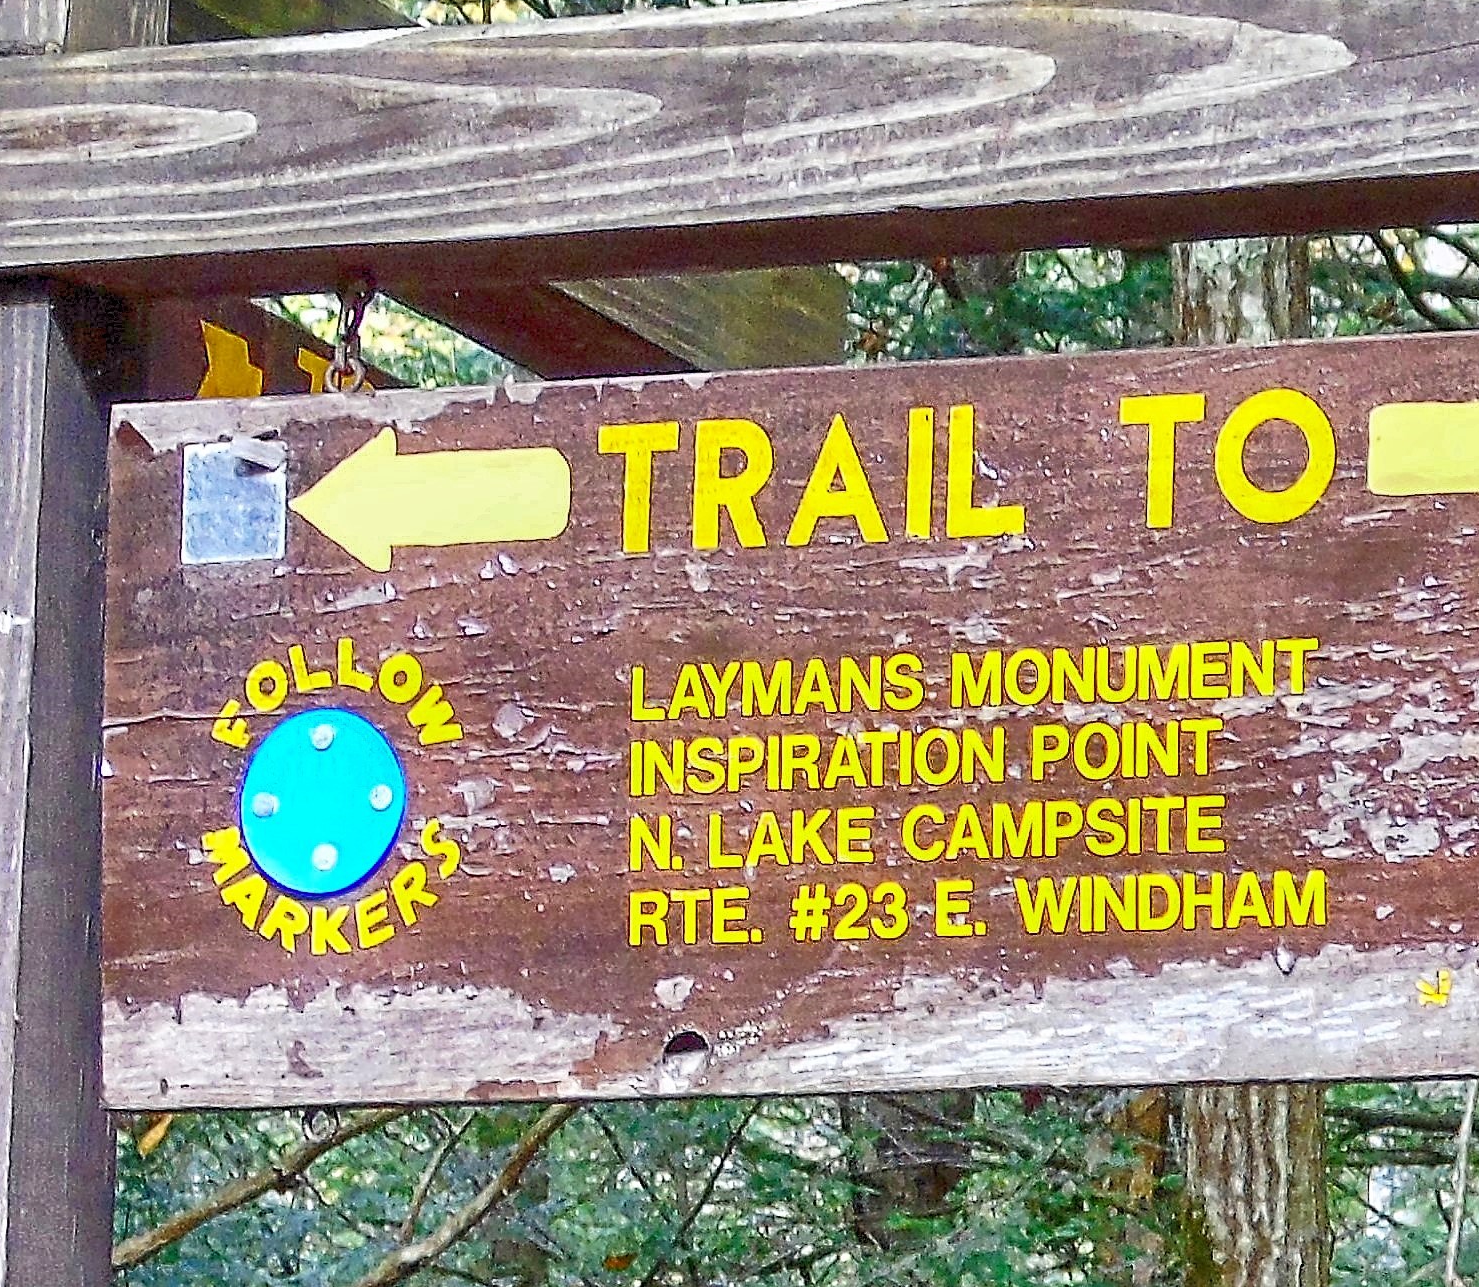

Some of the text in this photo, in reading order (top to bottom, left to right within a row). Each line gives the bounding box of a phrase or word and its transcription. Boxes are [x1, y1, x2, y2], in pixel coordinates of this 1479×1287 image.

[597, 386, 1337, 556] TRAIL TO
[210, 636, 465, 750] FOLLOW
[629, 652, 925, 723] LAYMANS
[949, 636, 1320, 709] MONUMENT
[628, 726, 1007, 798] INSPIRATION
[1030, 716, 1225, 783] POINT
[628, 813, 685, 873] N.
[708, 806, 876, 870] LAKE
[900, 793, 1227, 865] CAMPSITE
[201, 817, 465, 956] MARKERS
[628, 881, 764, 948] RTE.
[789, 879, 912, 942] #23
[934, 876, 988, 938] E.
[1013, 867, 1329, 936] WINDHAM
